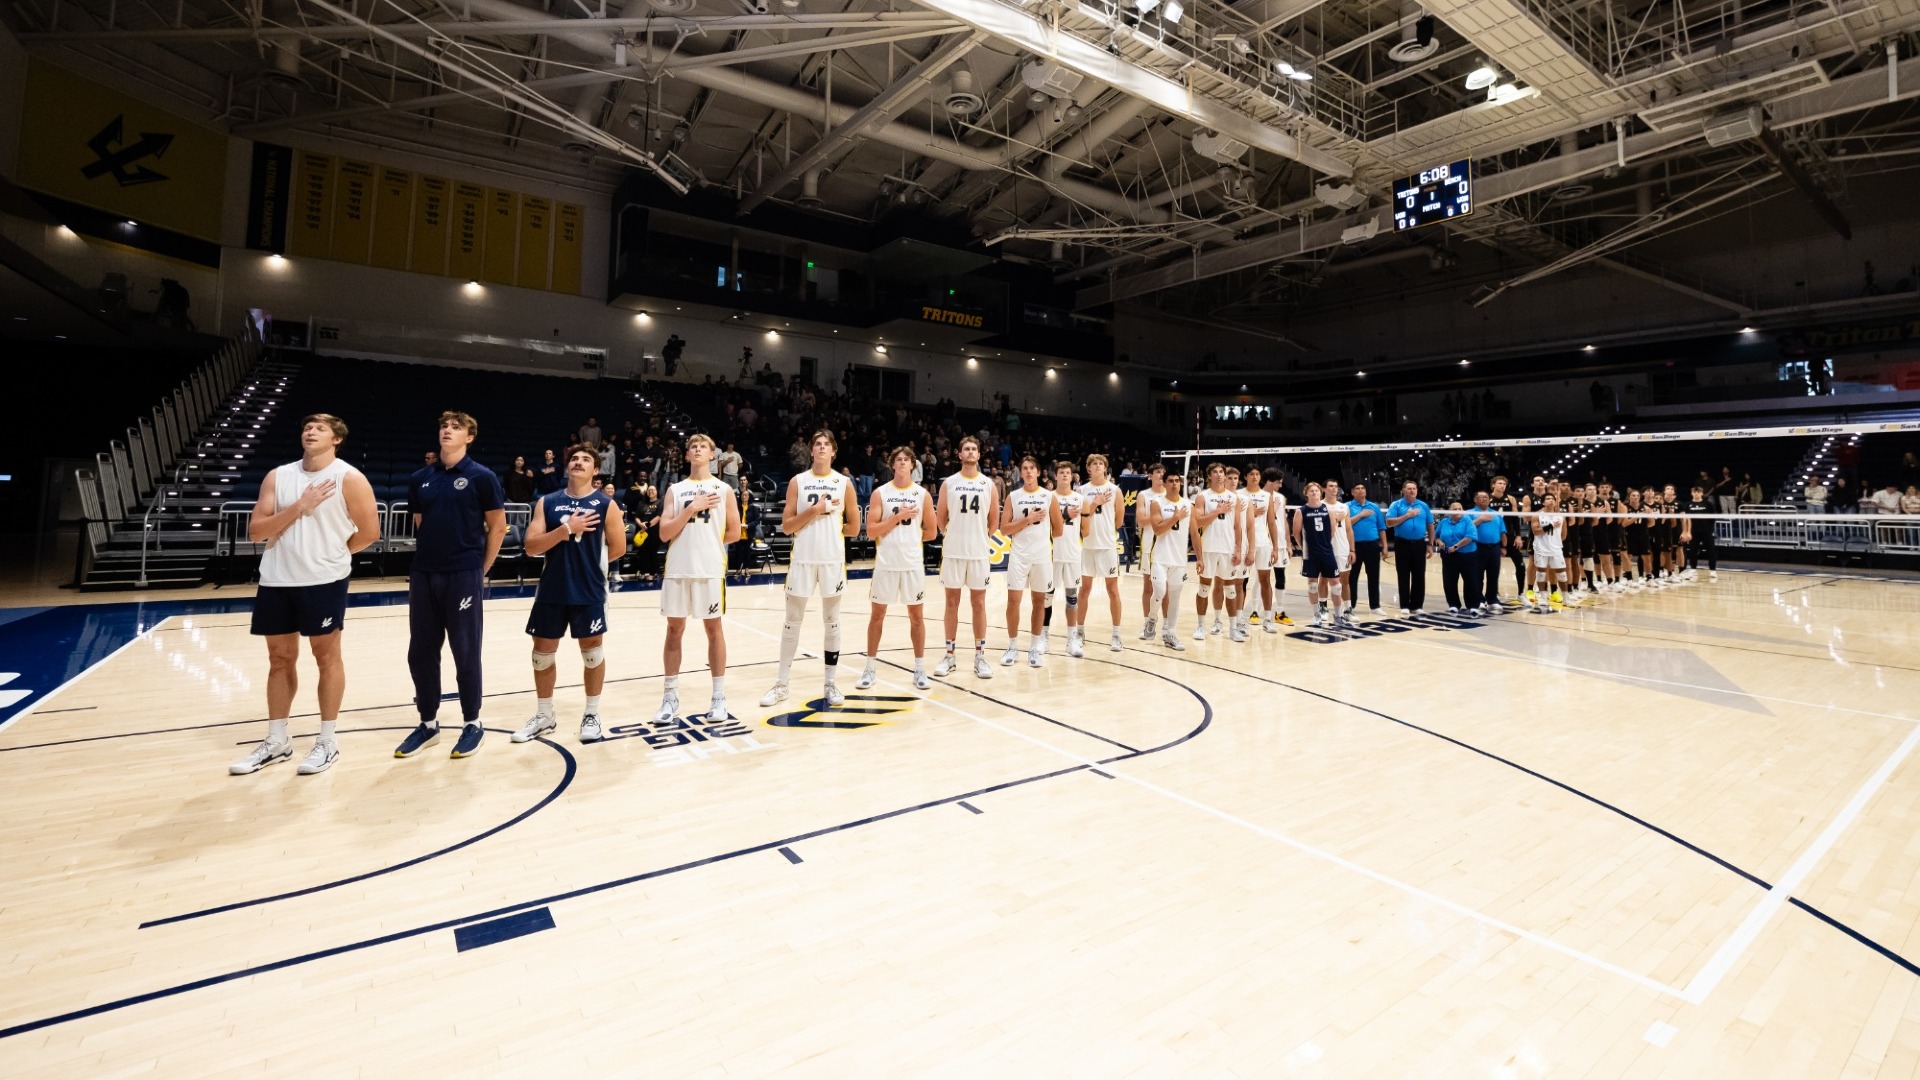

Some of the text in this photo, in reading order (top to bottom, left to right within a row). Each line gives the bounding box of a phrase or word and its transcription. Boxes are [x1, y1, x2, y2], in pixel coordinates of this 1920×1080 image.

[1420, 165, 1448, 184] 6:08
[1459, 181, 1468, 194] 0
[260, 160, 278, 247] NATIONAL CHAMPIONS
[1406, 196, 1414, 208] 0
[1461, 203, 1469, 213] 0
[1399, 219, 1406, 229] 0
[1410, 218, 1415, 226] 0
[922, 306, 983, 327] TRITONS
[960, 494, 979, 514] 14
[1314, 517, 1324, 531] 5
[643, 721, 753, 750] BIG
[645, 733, 781, 768] THE
